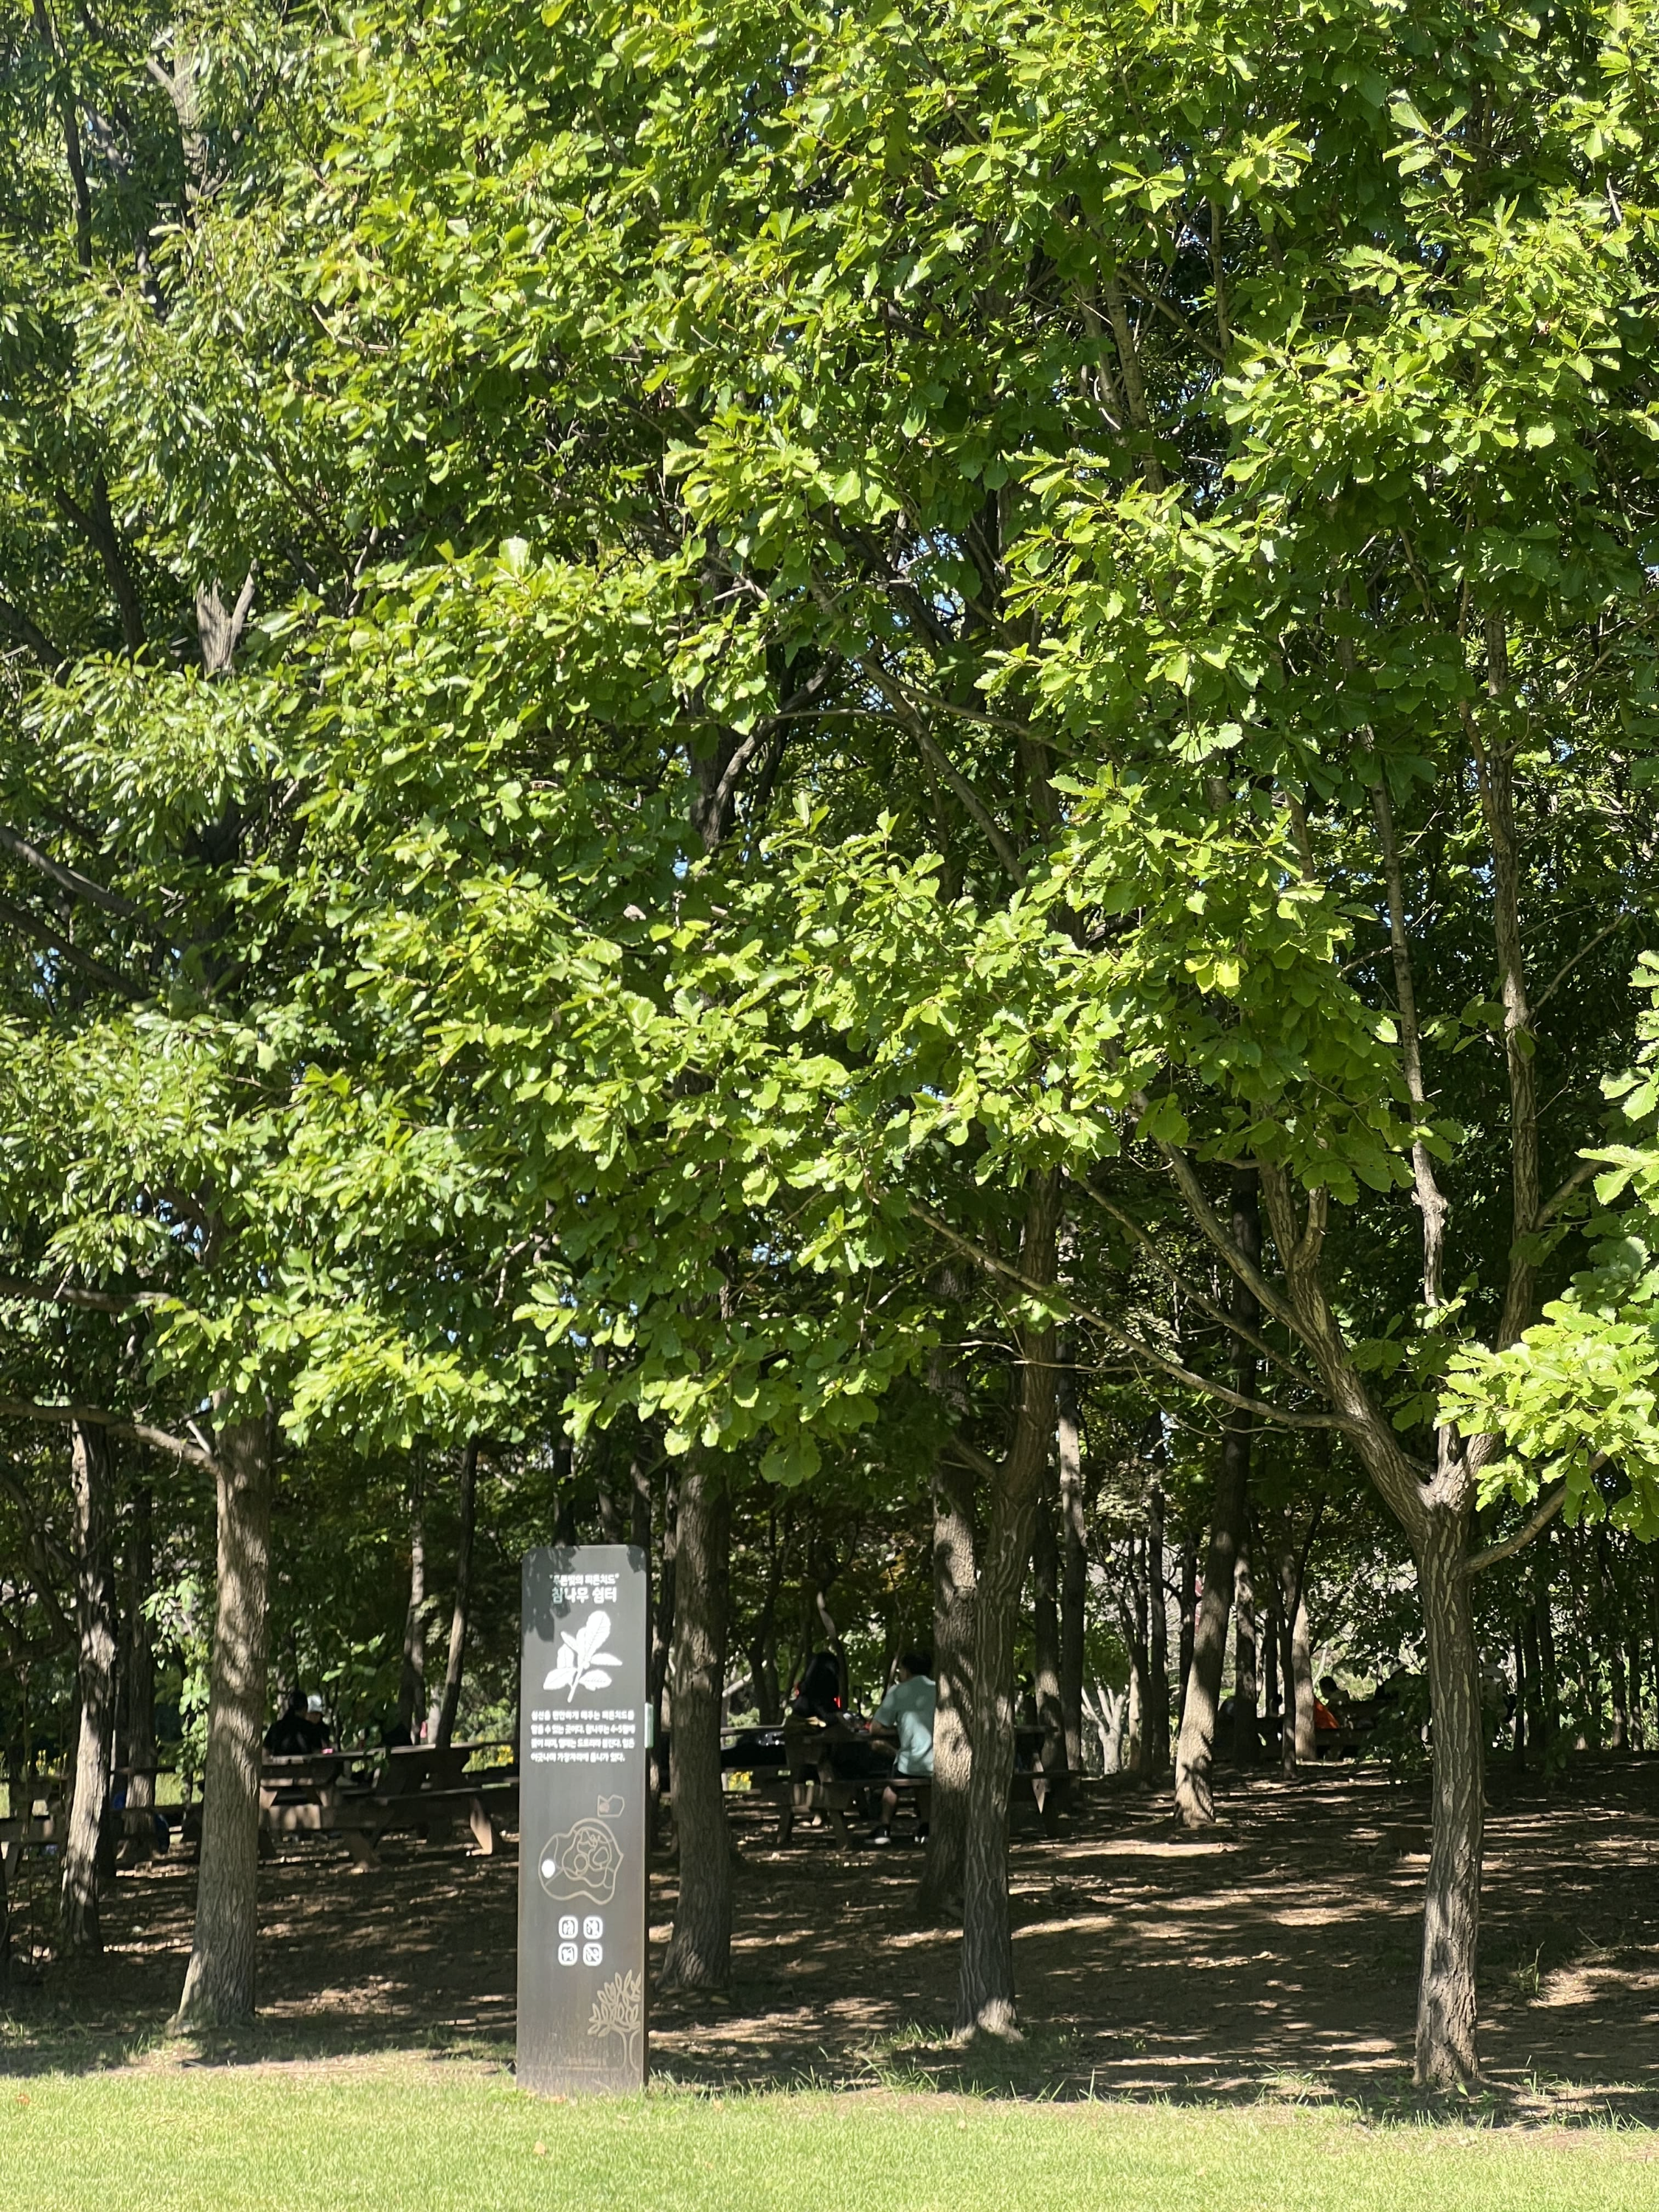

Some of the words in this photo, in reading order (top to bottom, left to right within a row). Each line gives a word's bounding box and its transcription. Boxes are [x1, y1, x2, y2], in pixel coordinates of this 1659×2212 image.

[552, 1587, 589, 1604] 참나무
[592, 1587, 616, 1604] 쉼터
[545, 1725, 551, 1734] 수
[552, 1725, 564, 1734] 있는
[585, 1724, 609, 1734] 참나무는
